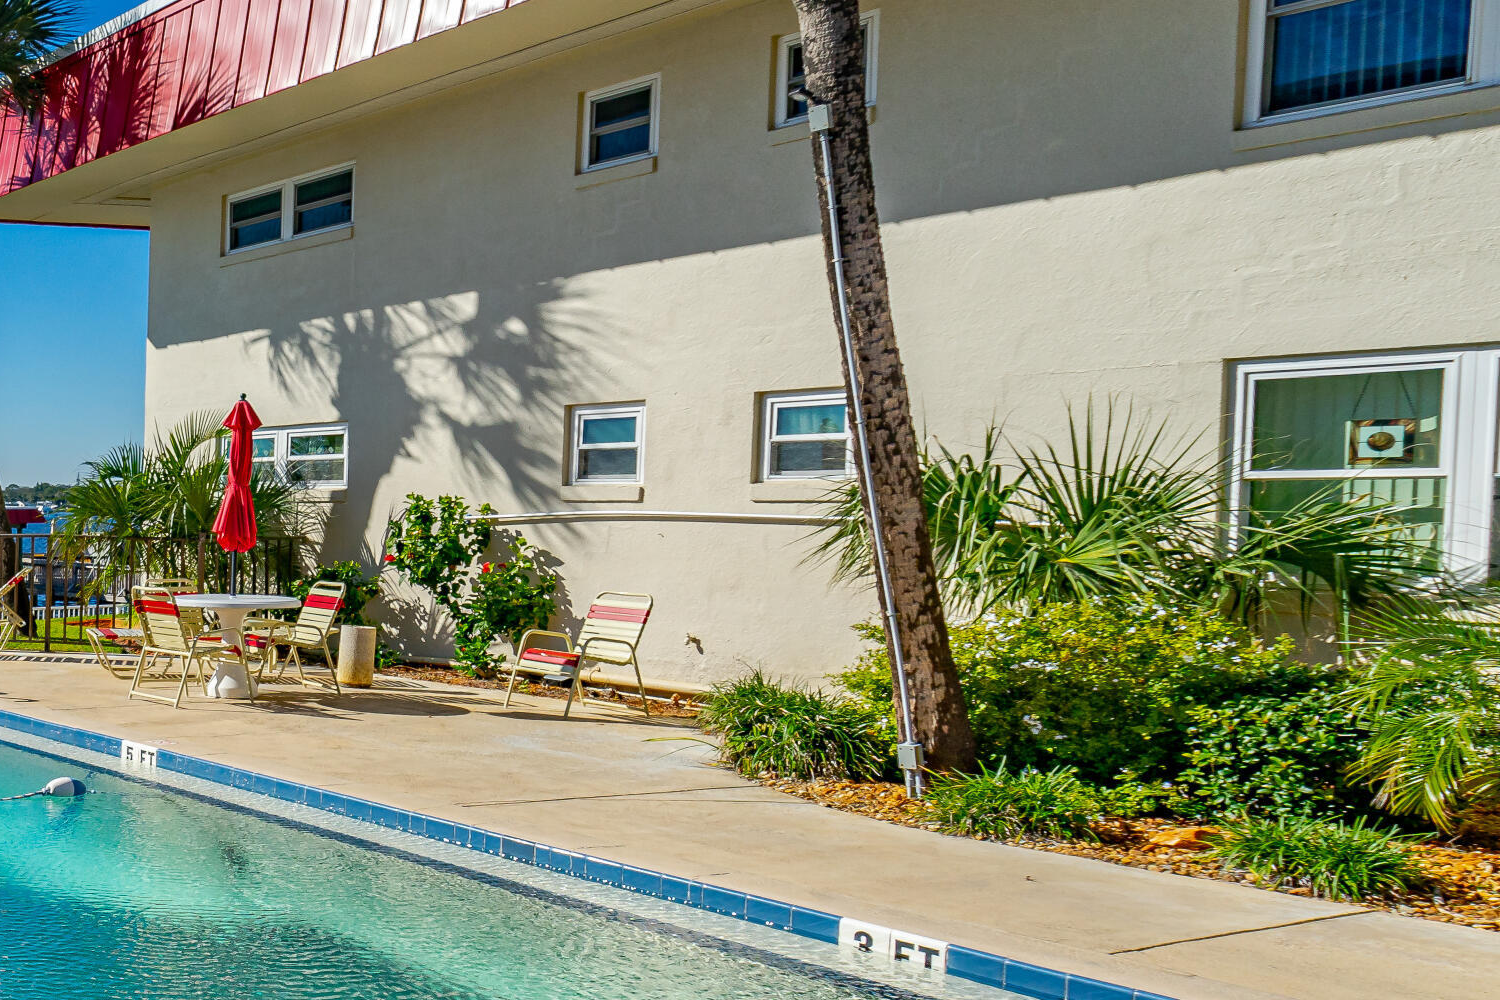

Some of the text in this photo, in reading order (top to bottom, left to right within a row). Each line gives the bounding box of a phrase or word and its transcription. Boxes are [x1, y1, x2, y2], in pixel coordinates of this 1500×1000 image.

[126, 745, 155, 766] 5 FT
[853, 930, 940, 970] 3 FT
